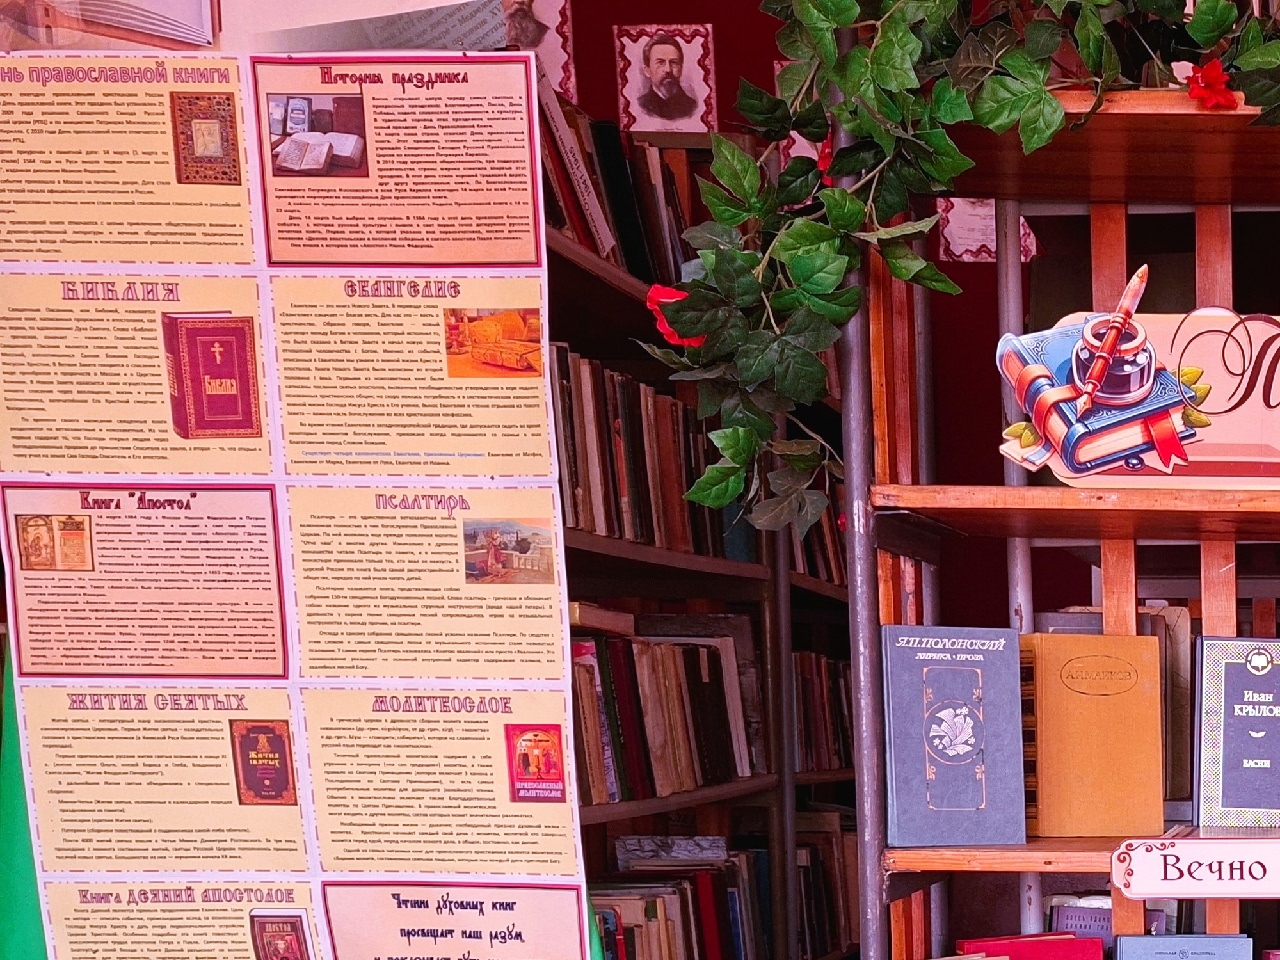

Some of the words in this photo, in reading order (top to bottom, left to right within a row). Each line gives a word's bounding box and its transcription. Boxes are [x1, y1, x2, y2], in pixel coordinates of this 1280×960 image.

[320, 67, 383, 86] История
[392, 71, 469, 93] праздника
[61, 281, 181, 302] БИБЛИЯ
[344, 280, 461, 298] ЕВАНГЕЛИЕ
[79, 491, 121, 510] Книга
[128, 491, 198, 511] "Апостол"
[375, 493, 470, 517] ПСАЛТИРЬ
[896, 636, 1007, 652] Я.П.ПОЛОНСКИЙ
[67, 693, 148, 711] ЖИТИЯ
[154, 693, 249, 711] СВЯТЫХ
[371, 695, 513, 714] МОЛИТВОСЛОВ
[1243, 691, 1273, 702] Иван
[1243, 759, 1271, 768] БАСНИ
[1160, 853, 1268, 882] Вечно
[78, 888, 122, 904] Книга
[126, 886, 196, 906] ДЕЯНИЙ
[200, 887, 296, 903] АПОСТОЛОВ
